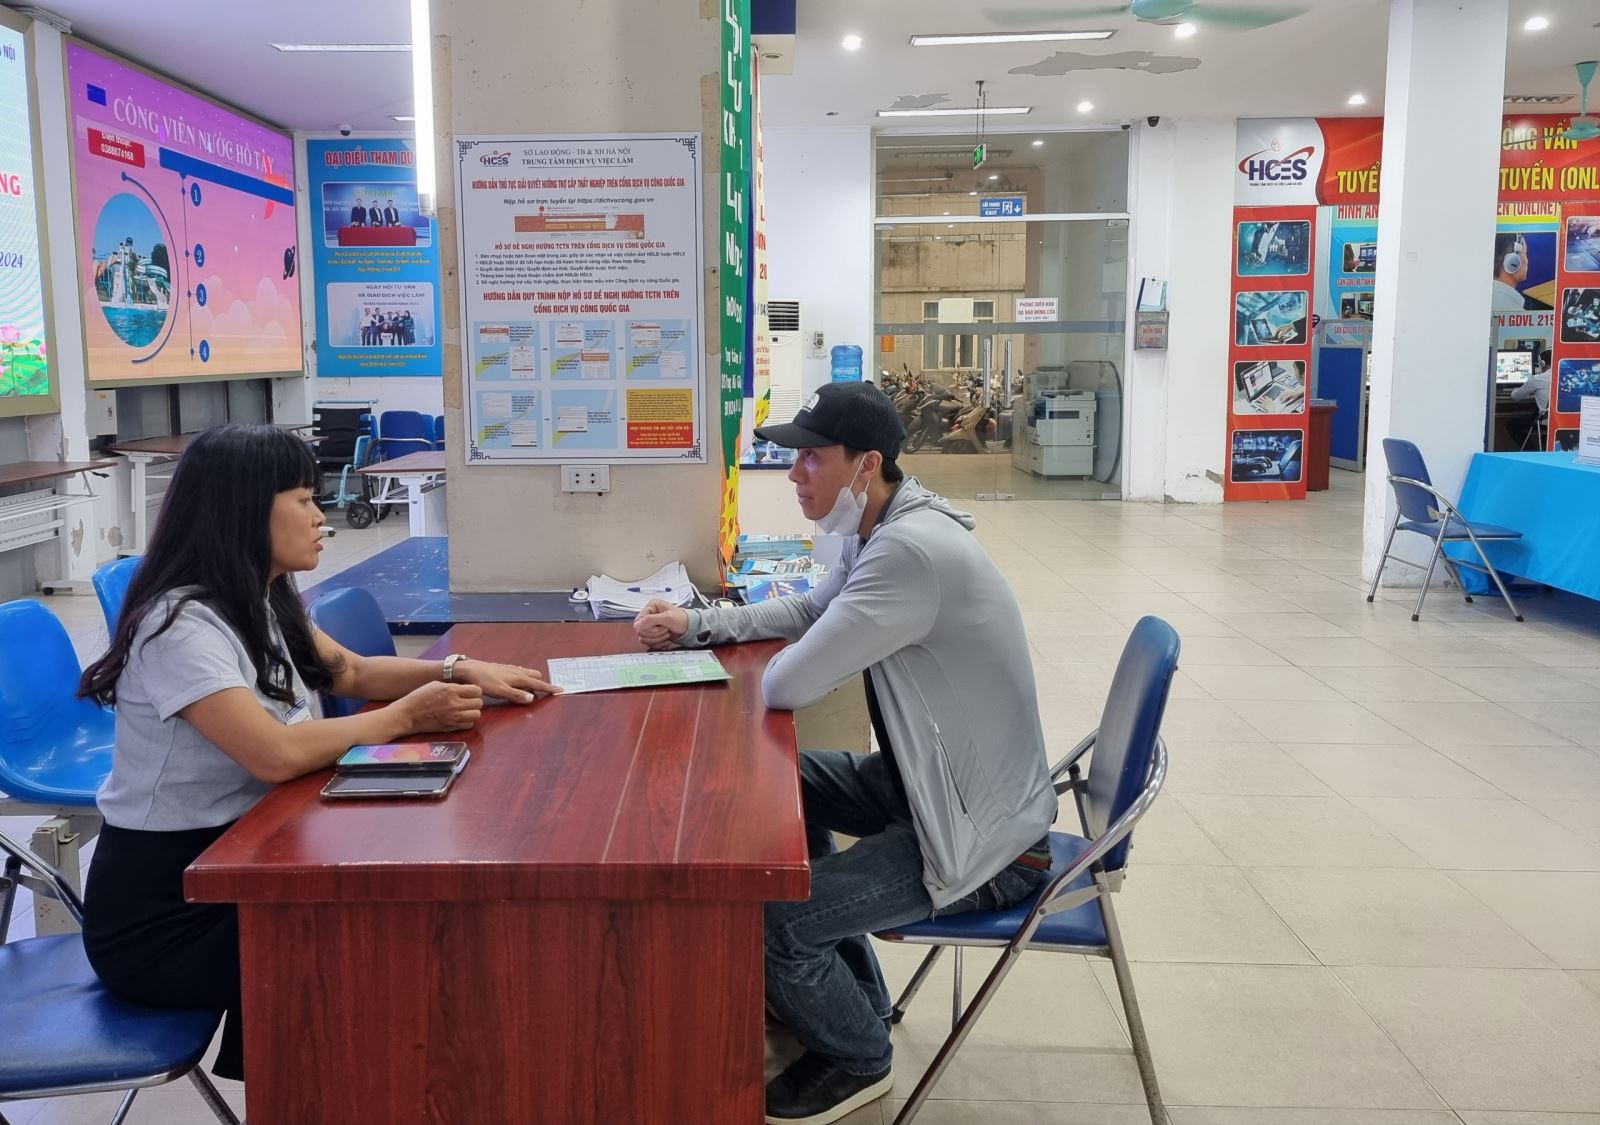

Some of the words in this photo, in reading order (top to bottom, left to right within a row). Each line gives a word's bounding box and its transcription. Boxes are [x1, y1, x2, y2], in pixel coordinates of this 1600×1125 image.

[113, 96, 159, 134] CÔNG
[162, 116, 196, 148] VIÊN
[199, 130, 234, 160] NƯỚC
[236, 142, 252, 166] HỒ
[254, 149, 274, 175] TÂY
[369, 151, 397, 166] THAM
[484, 157, 509, 166] HCES
[548, 157, 565, 166] TÂM
[566, 158, 585, 167] DỊCH
[586, 158, 596, 166] VỤ
[598, 156, 615, 166] VIỆC
[617, 156, 633, 165] LÀM
[1248, 159, 1307, 180] HCES
[1338, 160, 1380, 193] TUYỂ
[1500, 160, 1554, 191] TUYẾN
[483, 291, 506, 301] HƯỚNG
[507, 291, 521, 301] DẪN
[537, 291, 556, 300] TRÌNH
[557, 291, 571, 301] NỘP
[573, 290, 582, 300] HỒ
[593, 290, 602, 300] ĐỀ
[604, 292, 620, 301] NGHỊ
[621, 290, 644, 300] HƯỞNG
[663, 290, 680, 299] TRÊN
[534, 304, 552, 314] CỔNG
[553, 306, 569, 315] DỊCH
[570, 306, 578, 315] VỤ
[580, 303, 598, 313] CÔNG
[600, 303, 617, 313] QUỐC
[1509, 315, 1534, 326] GDVL
